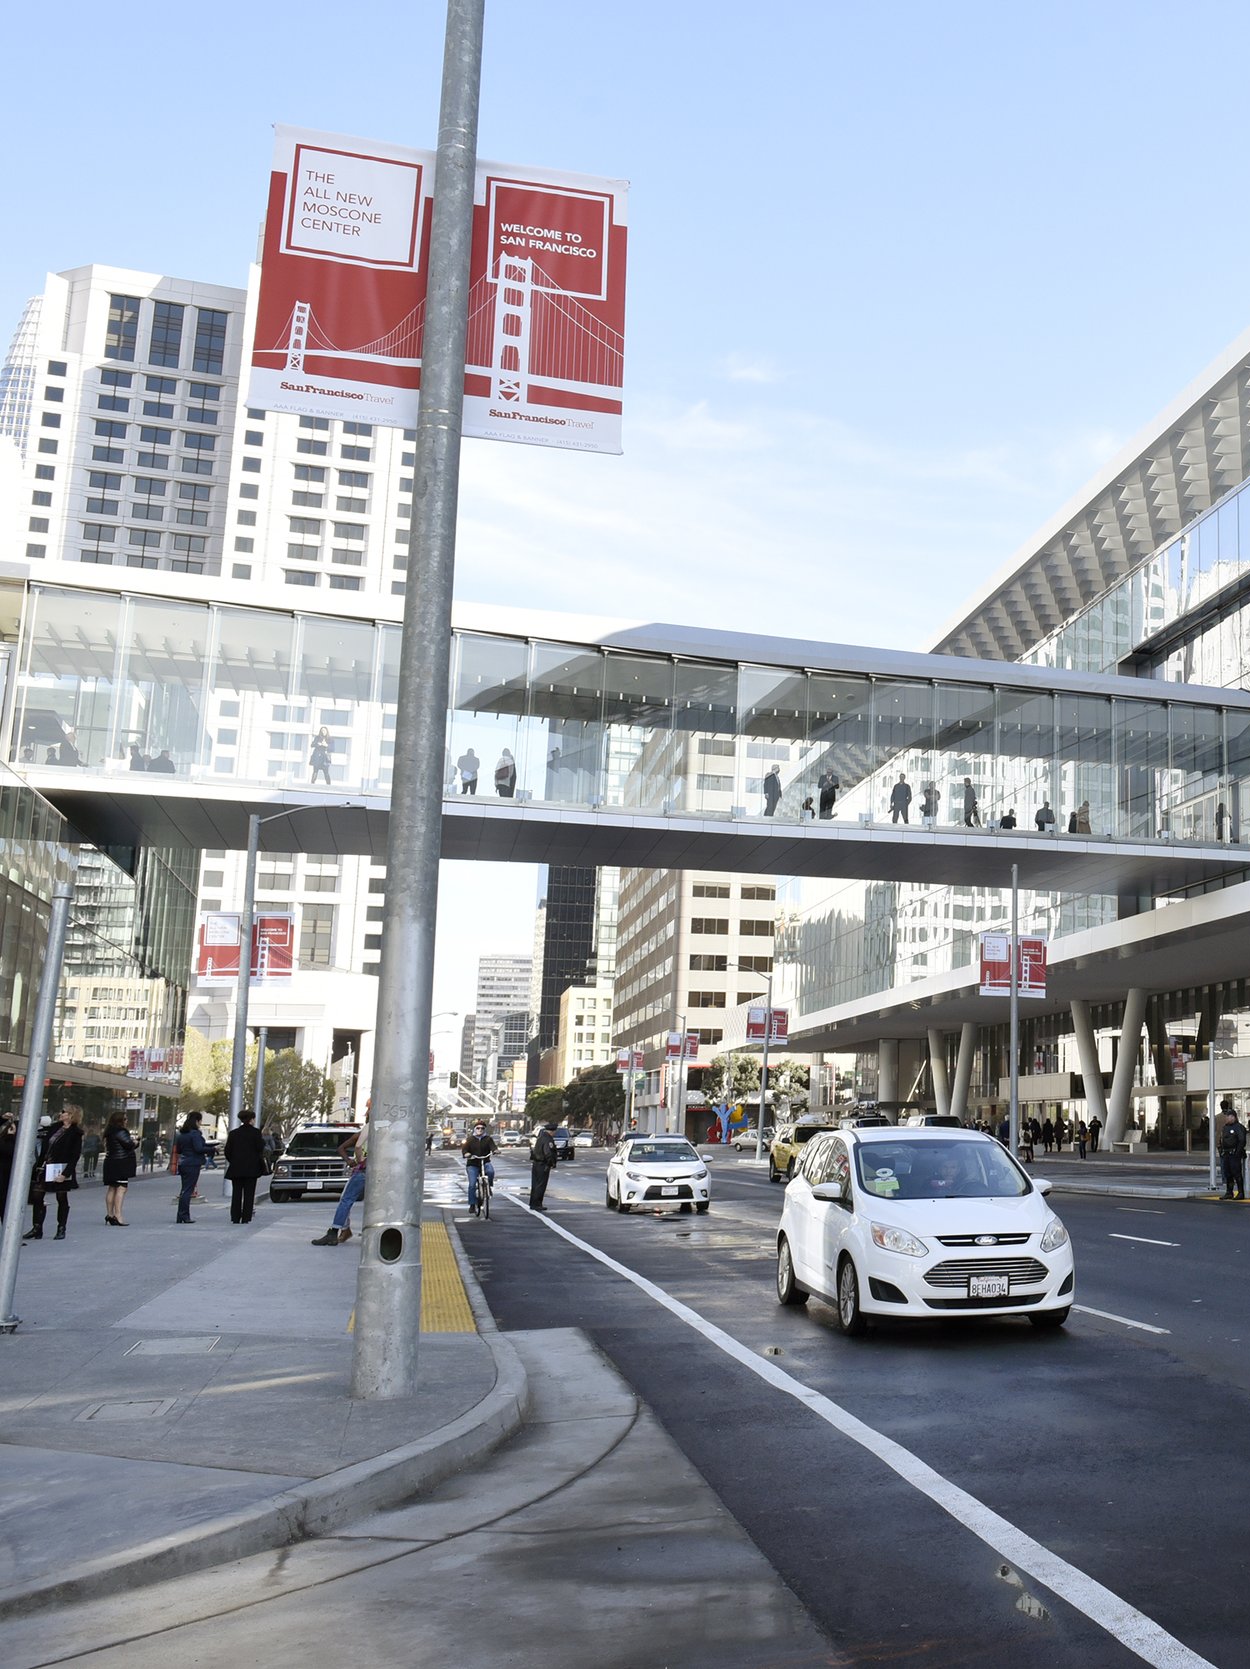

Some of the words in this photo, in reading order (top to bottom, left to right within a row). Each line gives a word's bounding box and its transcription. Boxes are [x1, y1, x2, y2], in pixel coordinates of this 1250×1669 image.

[306, 170, 335, 185] THE
[304, 186, 331, 200] ALL
[336, 191, 373, 207] NEW
[302, 201, 382, 224] MOSCONE
[301, 217, 361, 237] CENTER
[500, 222, 562, 241] WELCOME
[565, 232, 582, 244] TO
[500, 235, 526, 247] SAN
[529, 239, 597, 258] FRANCISCO
[273, 403, 289, 411] AAA
[316, 409, 344, 418] BANNER
